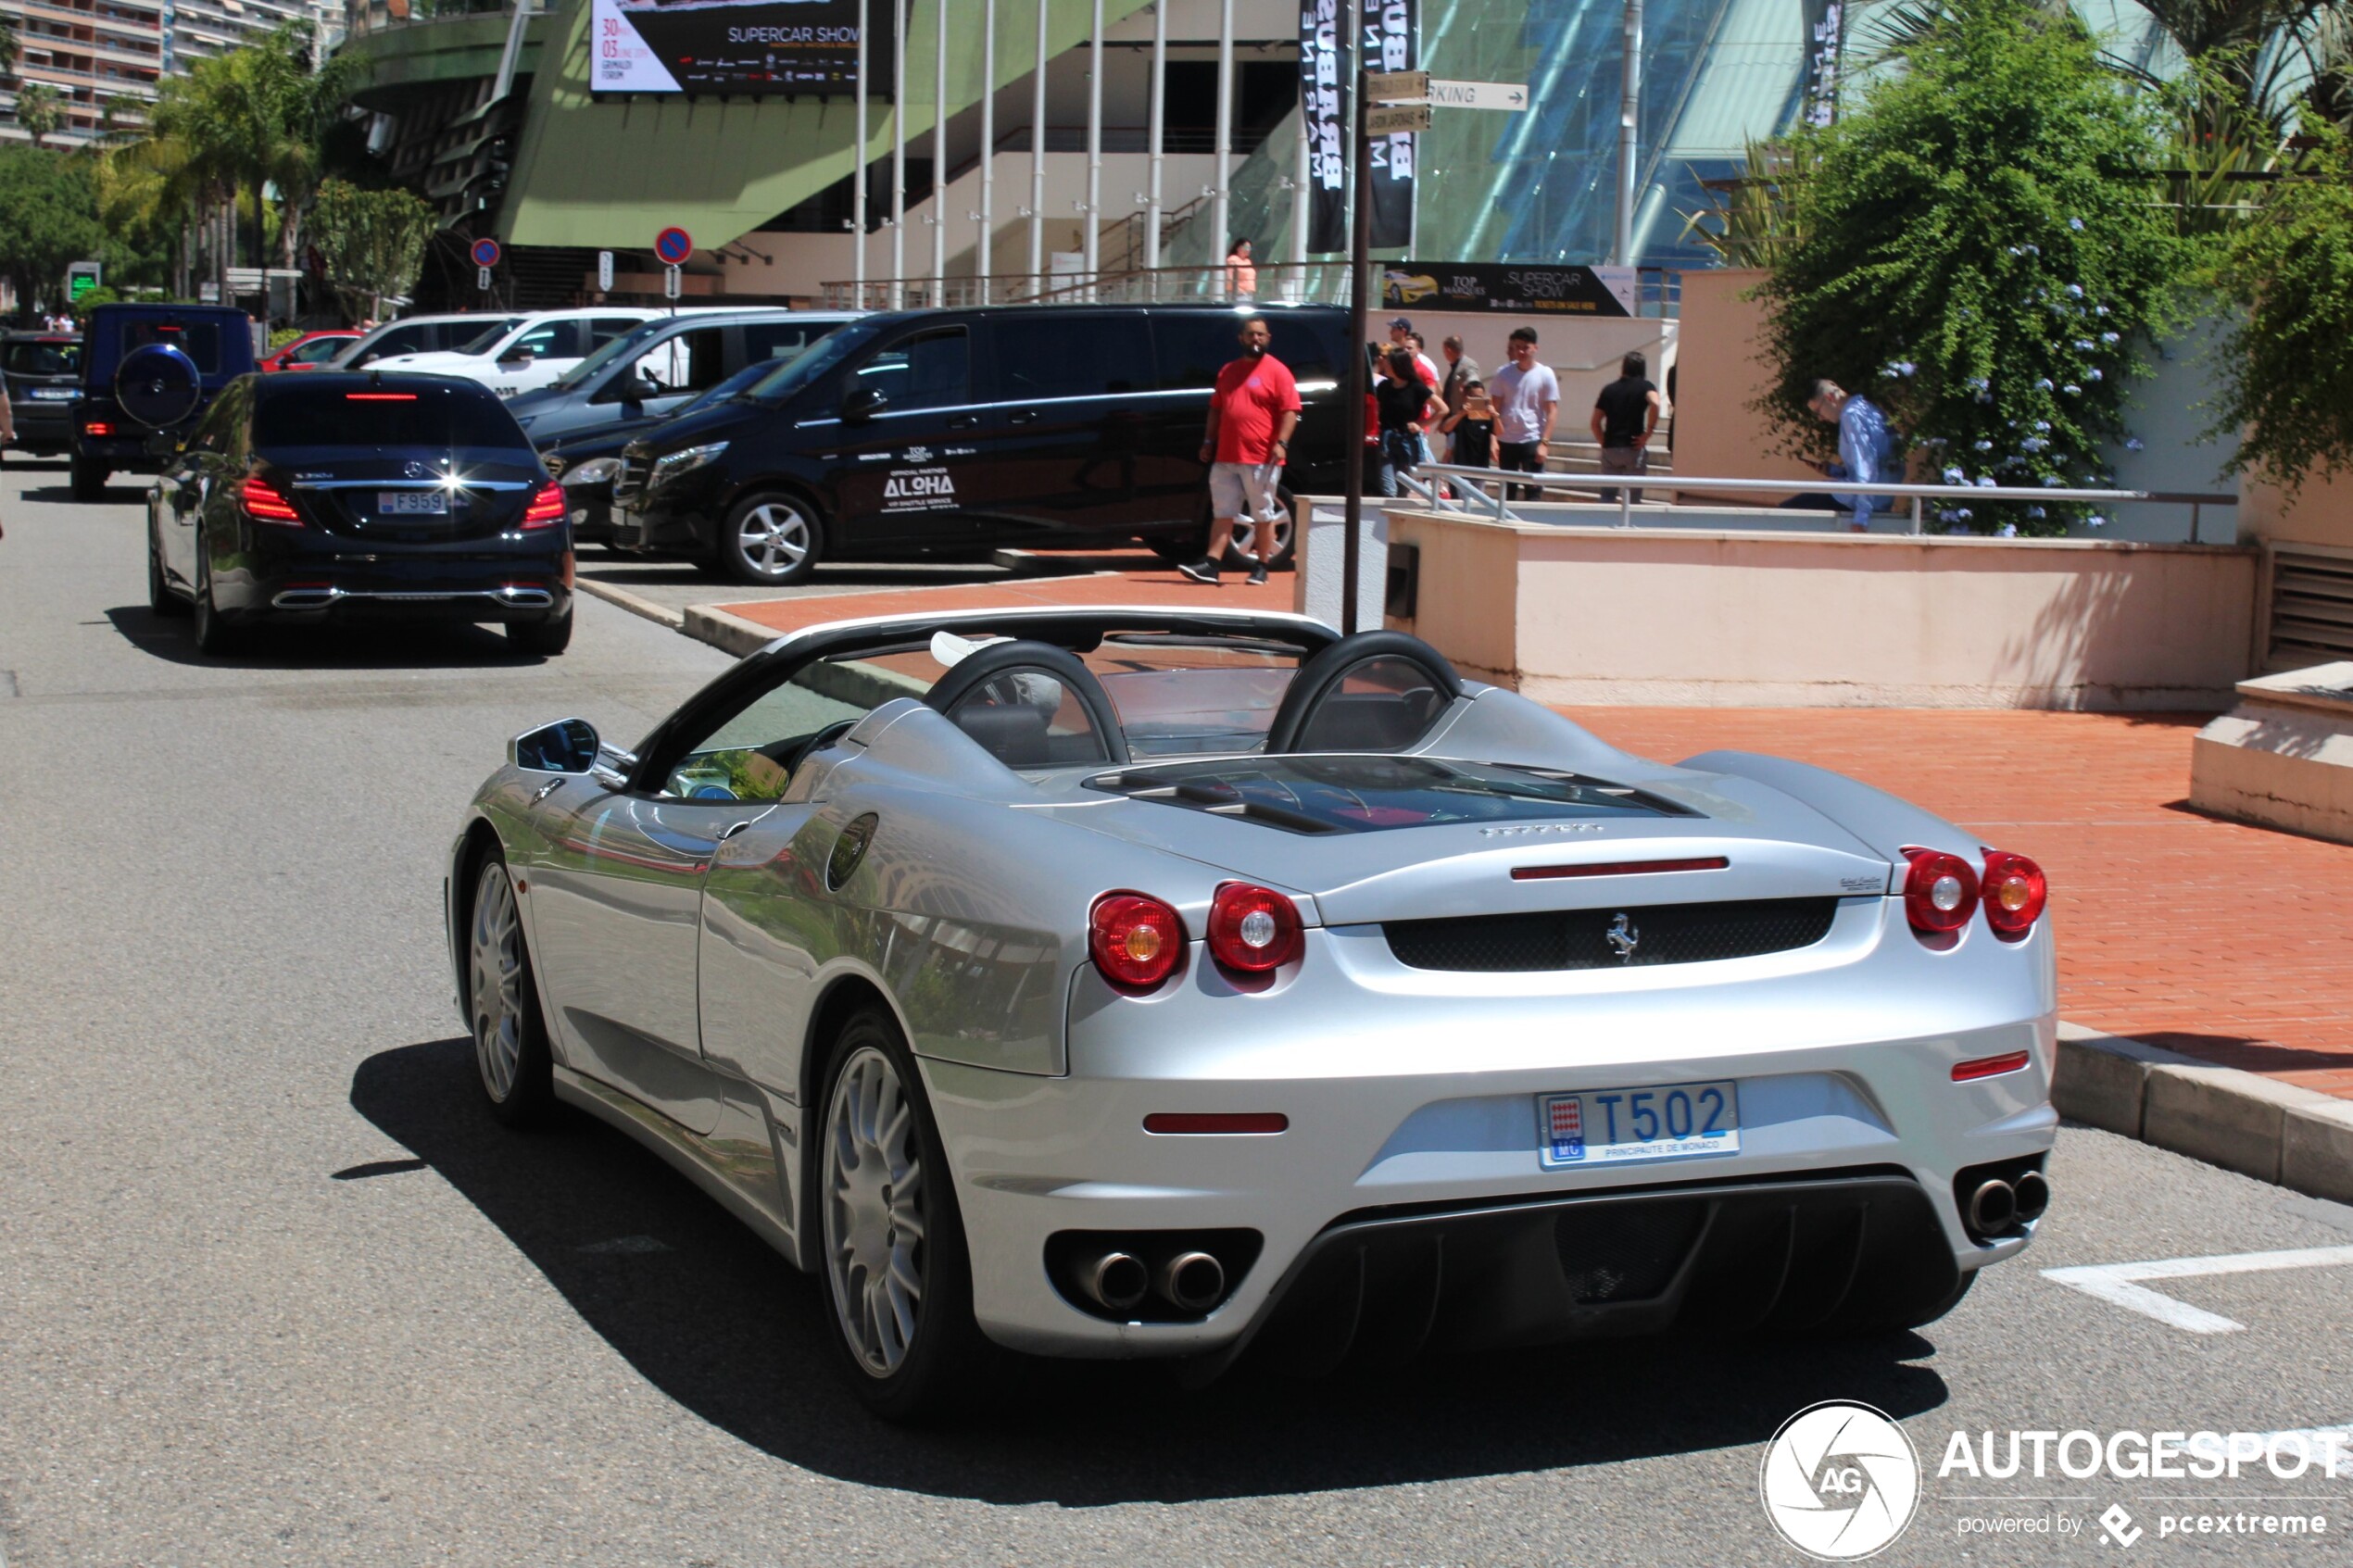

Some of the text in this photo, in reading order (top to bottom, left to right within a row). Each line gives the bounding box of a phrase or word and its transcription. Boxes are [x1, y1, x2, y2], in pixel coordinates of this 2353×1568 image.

[602, 18, 618, 37] 30
[728, 26, 812, 43] SUPERCAR
[602, 40, 618, 57] 03
[1452, 275, 1478, 287] TOP
[1507, 271, 1581, 286] SUPERCAR
[1522, 284, 1566, 297] SHOW
[883, 474, 956, 498] ALOHA
[396, 494, 443, 509] F959
[1595, 1087, 1728, 1147] T502
[1558, 1139, 1580, 1156] MC
[1605, 1140, 1719, 1157] PRINCIPAUTE DE MONACO
